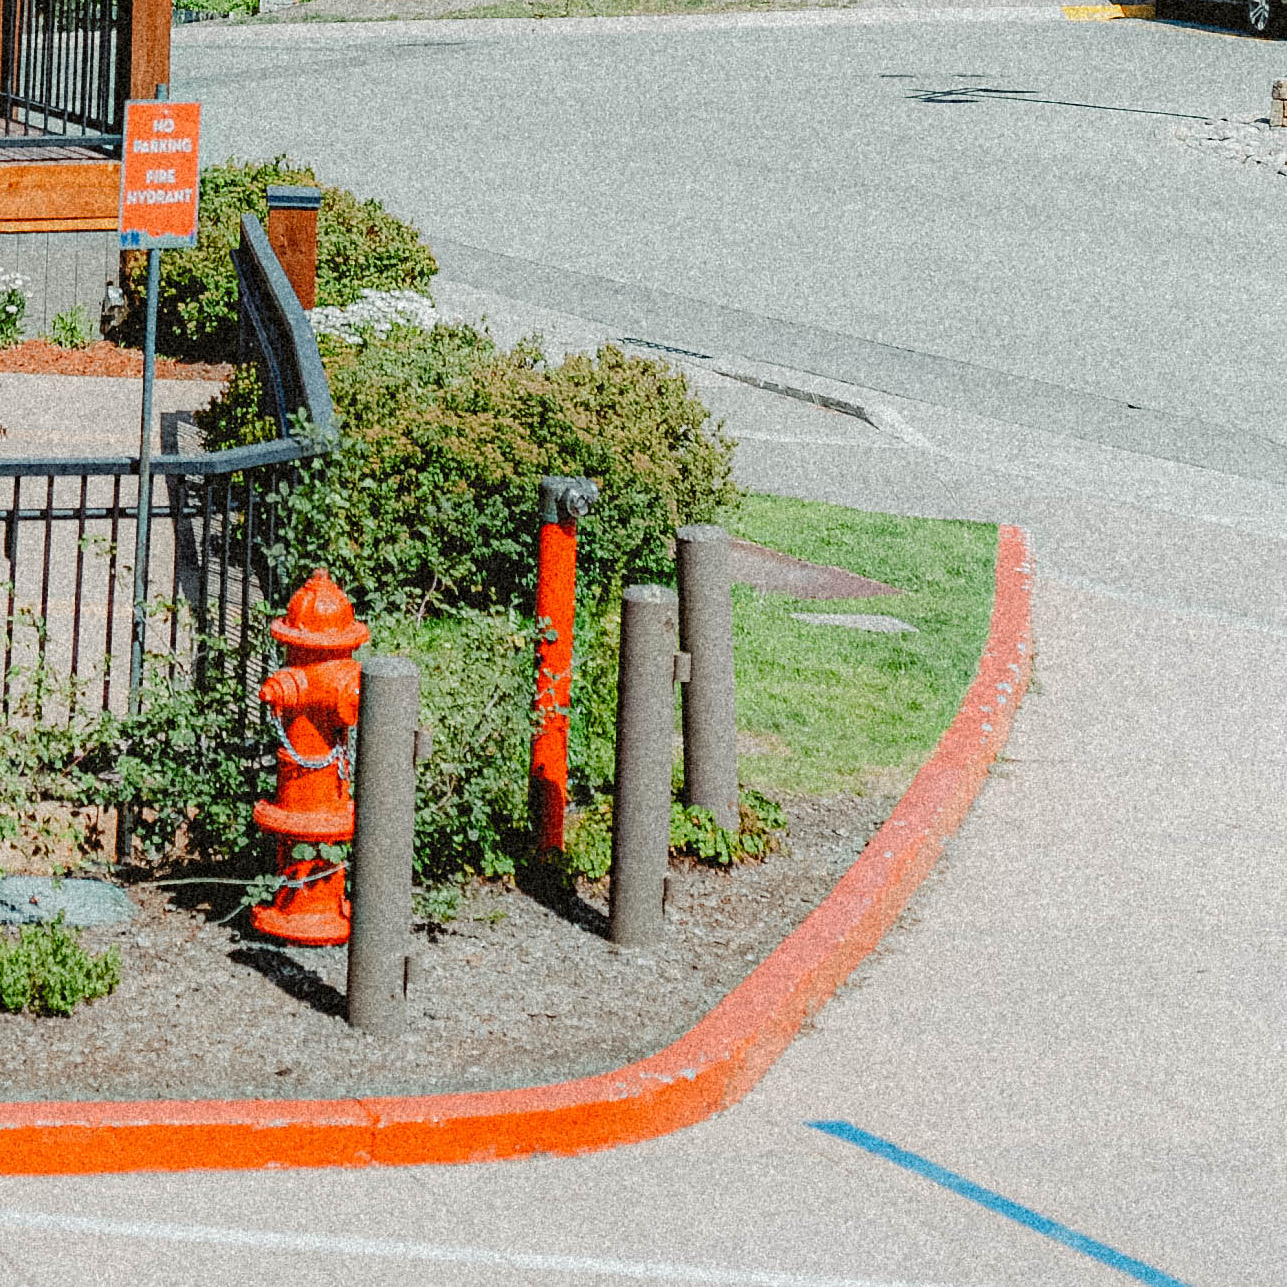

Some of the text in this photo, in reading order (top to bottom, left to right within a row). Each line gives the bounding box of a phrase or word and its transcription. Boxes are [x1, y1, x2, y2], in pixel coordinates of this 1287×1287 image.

[153, 119, 175, 133] NO
[133, 138, 192, 154] PARKING
[147, 169, 176, 184] FIRE
[128, 189, 193, 205] HYDRANT
